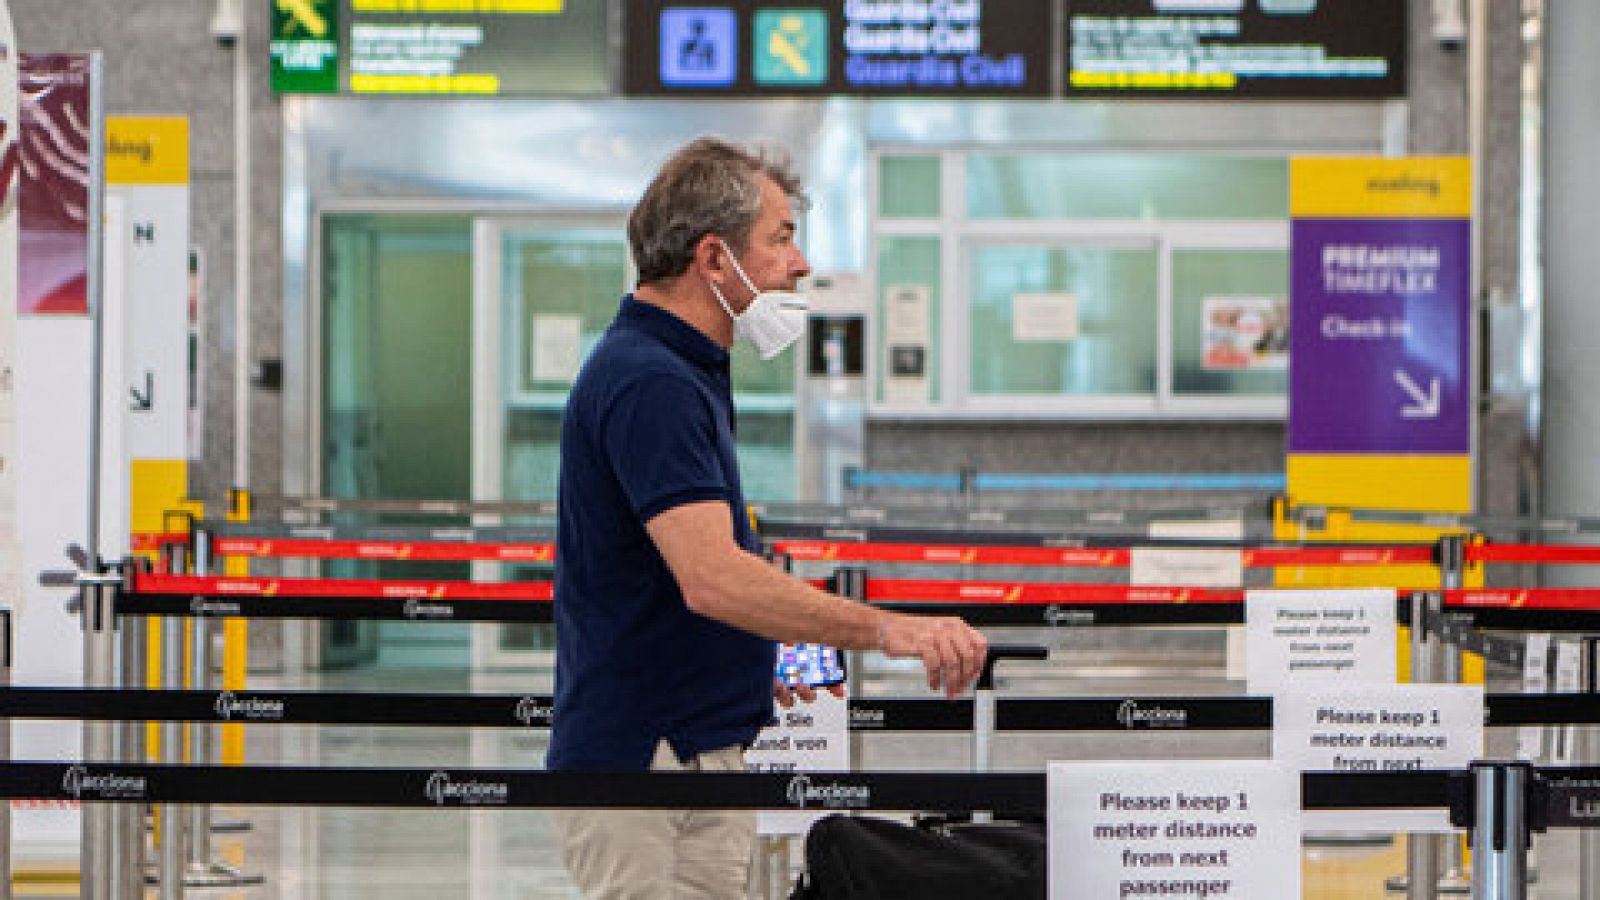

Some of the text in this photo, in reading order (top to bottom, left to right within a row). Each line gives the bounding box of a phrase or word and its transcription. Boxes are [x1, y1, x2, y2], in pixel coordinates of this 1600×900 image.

[845, 54, 1025, 85] Guardia Civil
[1323, 246, 1440, 271] PREMIUM
[1323, 271, 1437, 292] TIMEFLEX
[1276, 609, 1320, 621] Please
[1322, 609, 1354, 622] keep
[1315, 625, 1371, 637] distance
[1316, 709, 1440, 727] Please keep 1
[793, 738, 828, 751] von
[1310, 732, 1448, 748] meter distance
[1333, 754, 1421, 771] from next
[1099, 791, 1248, 815] Please keep 1
[1092, 820, 1257, 841] meter distance
[1122, 849, 1228, 867] from next
[1119, 879, 1231, 900] passenger
